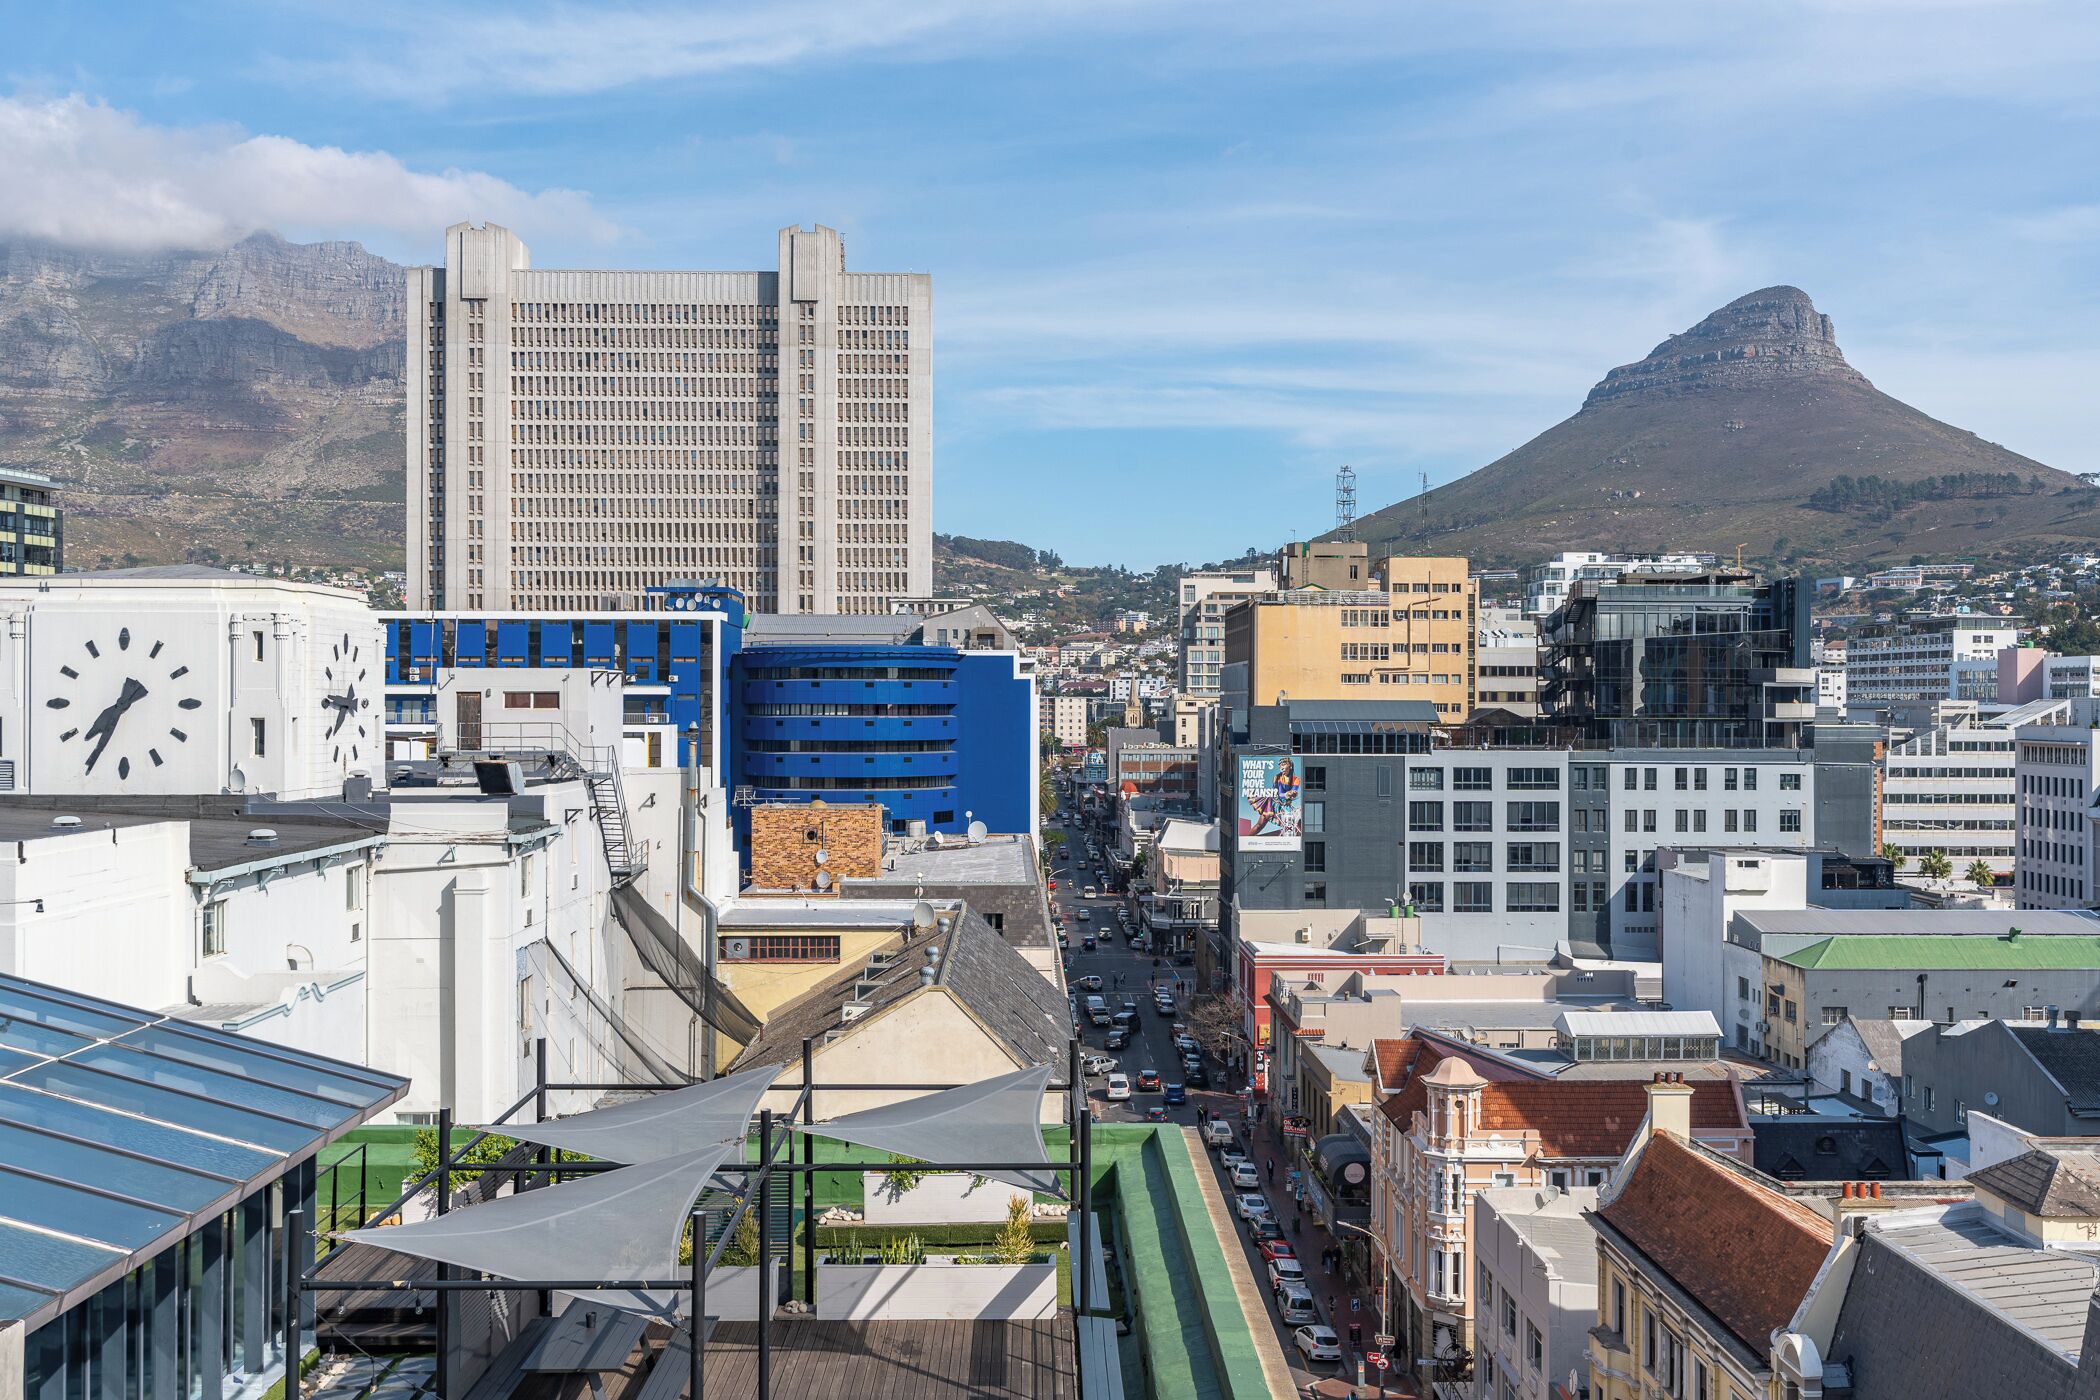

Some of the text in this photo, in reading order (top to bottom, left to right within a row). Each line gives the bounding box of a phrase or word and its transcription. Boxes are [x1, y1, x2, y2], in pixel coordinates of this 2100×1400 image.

[1242, 760, 1274, 770] WHAT'S
[1242, 770, 1264, 779] YOUR
[1242, 779, 1265, 788] MOVE
[1241, 788, 1279, 798] MZANSI?
